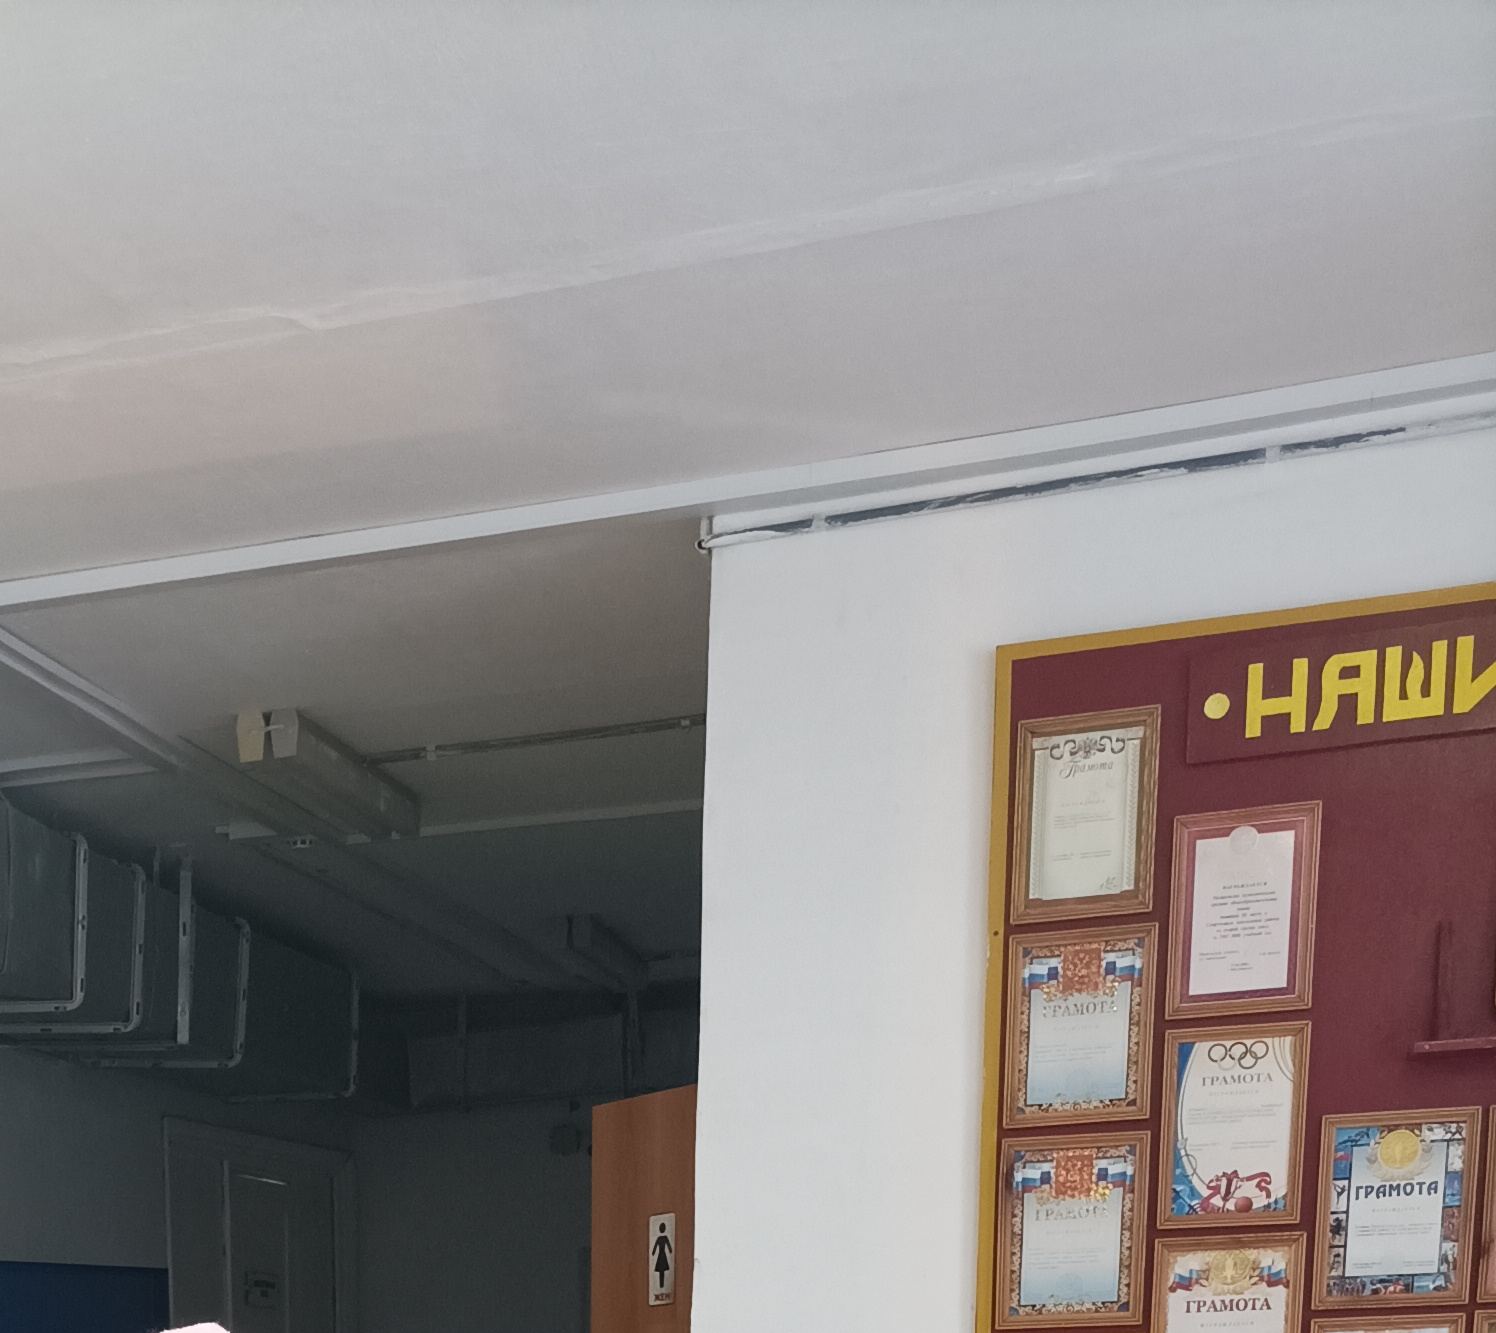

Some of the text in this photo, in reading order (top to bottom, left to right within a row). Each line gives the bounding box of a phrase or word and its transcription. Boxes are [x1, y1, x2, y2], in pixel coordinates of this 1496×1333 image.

[1059, 759, 1114, 779] Грамота
[1202, 1072, 1274, 1087] ГРАМОТА
[1354, 1180, 1439, 1201] ГРАМОТА
[1185, 1297, 1272, 1313] ГРАМОТА
